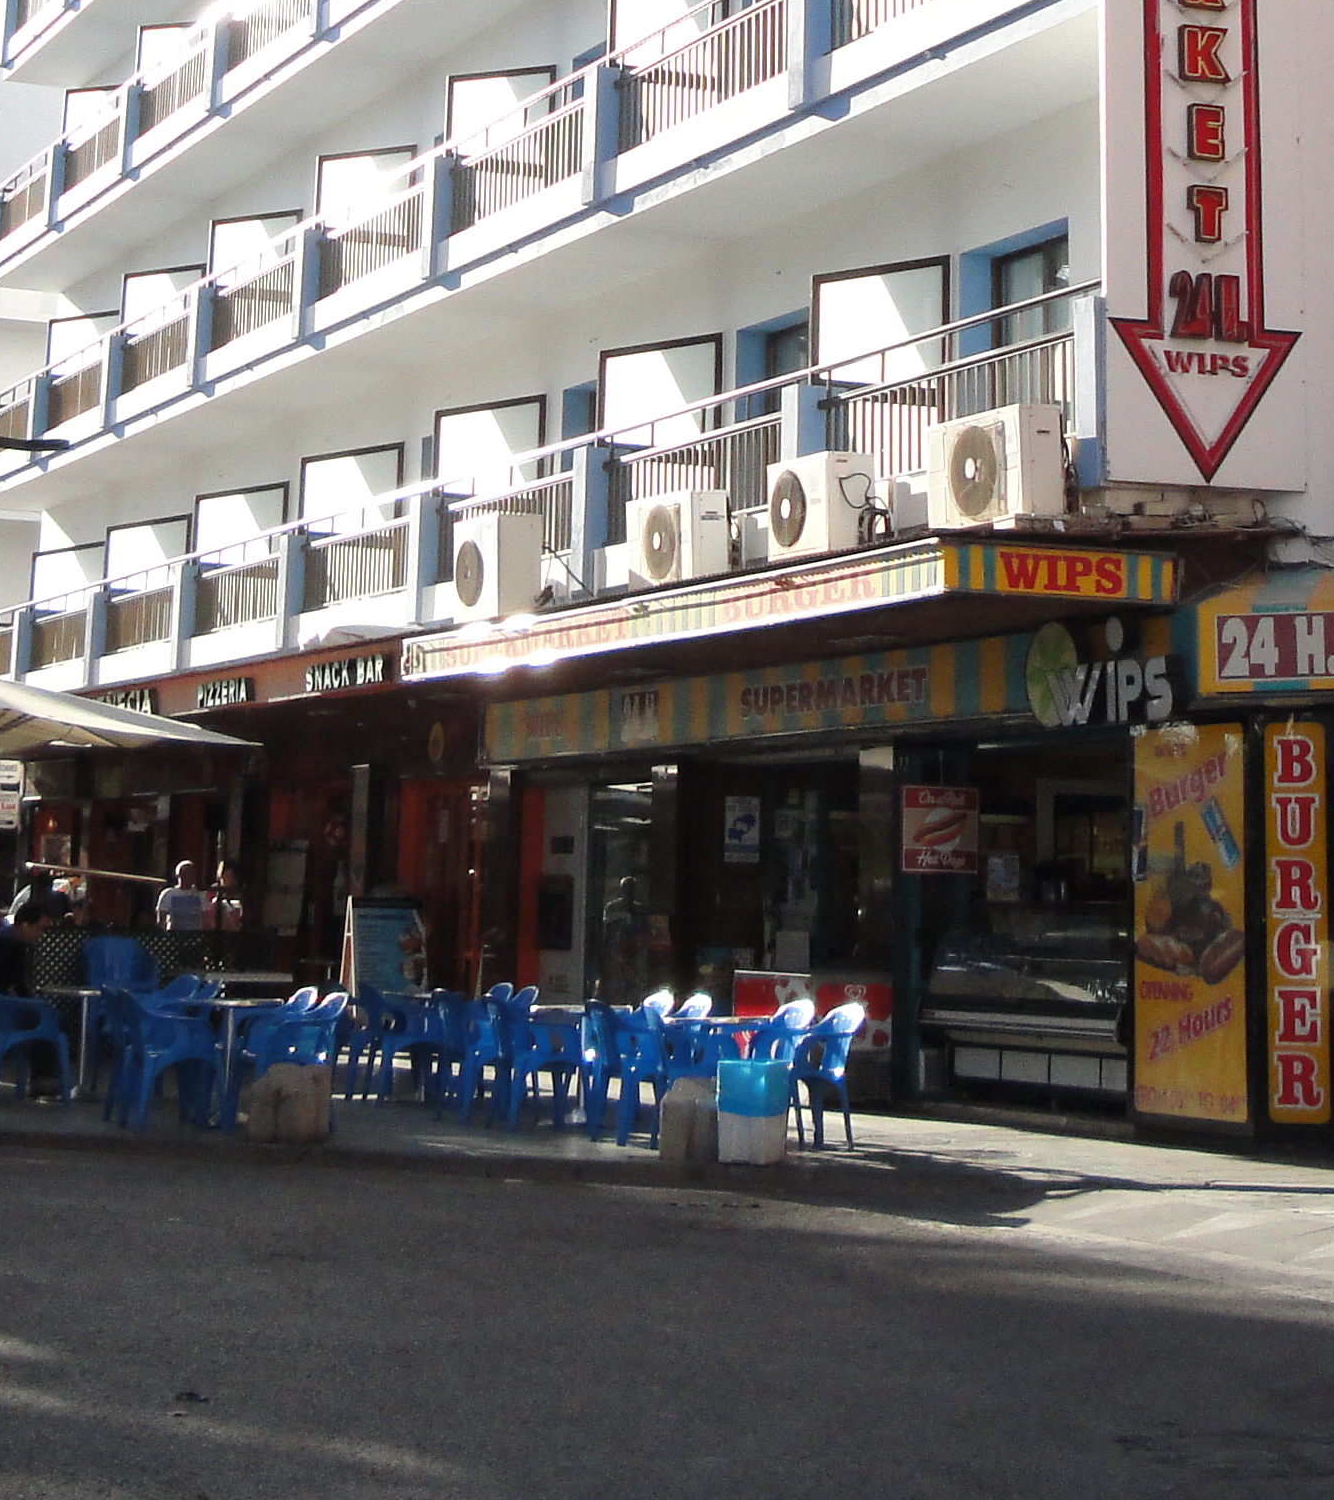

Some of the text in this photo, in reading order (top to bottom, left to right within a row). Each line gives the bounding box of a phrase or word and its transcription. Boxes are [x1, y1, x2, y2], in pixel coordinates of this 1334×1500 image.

[1163, 350, 1249, 378] WIPS
[999, 551, 1123, 595] WIPS
[721, 576, 877, 623] BURGER
[1220, 617, 1279, 677] 24
[197, 678, 247, 708] PIZZERIA
[305, 658, 350, 692] SNACK
[356, 653, 384, 684] BAR
[740, 667, 927, 717] SUPERMARKET
[1147, 751, 1226, 820] Burger
[1272, 735, 1321, 1108] BURGER
